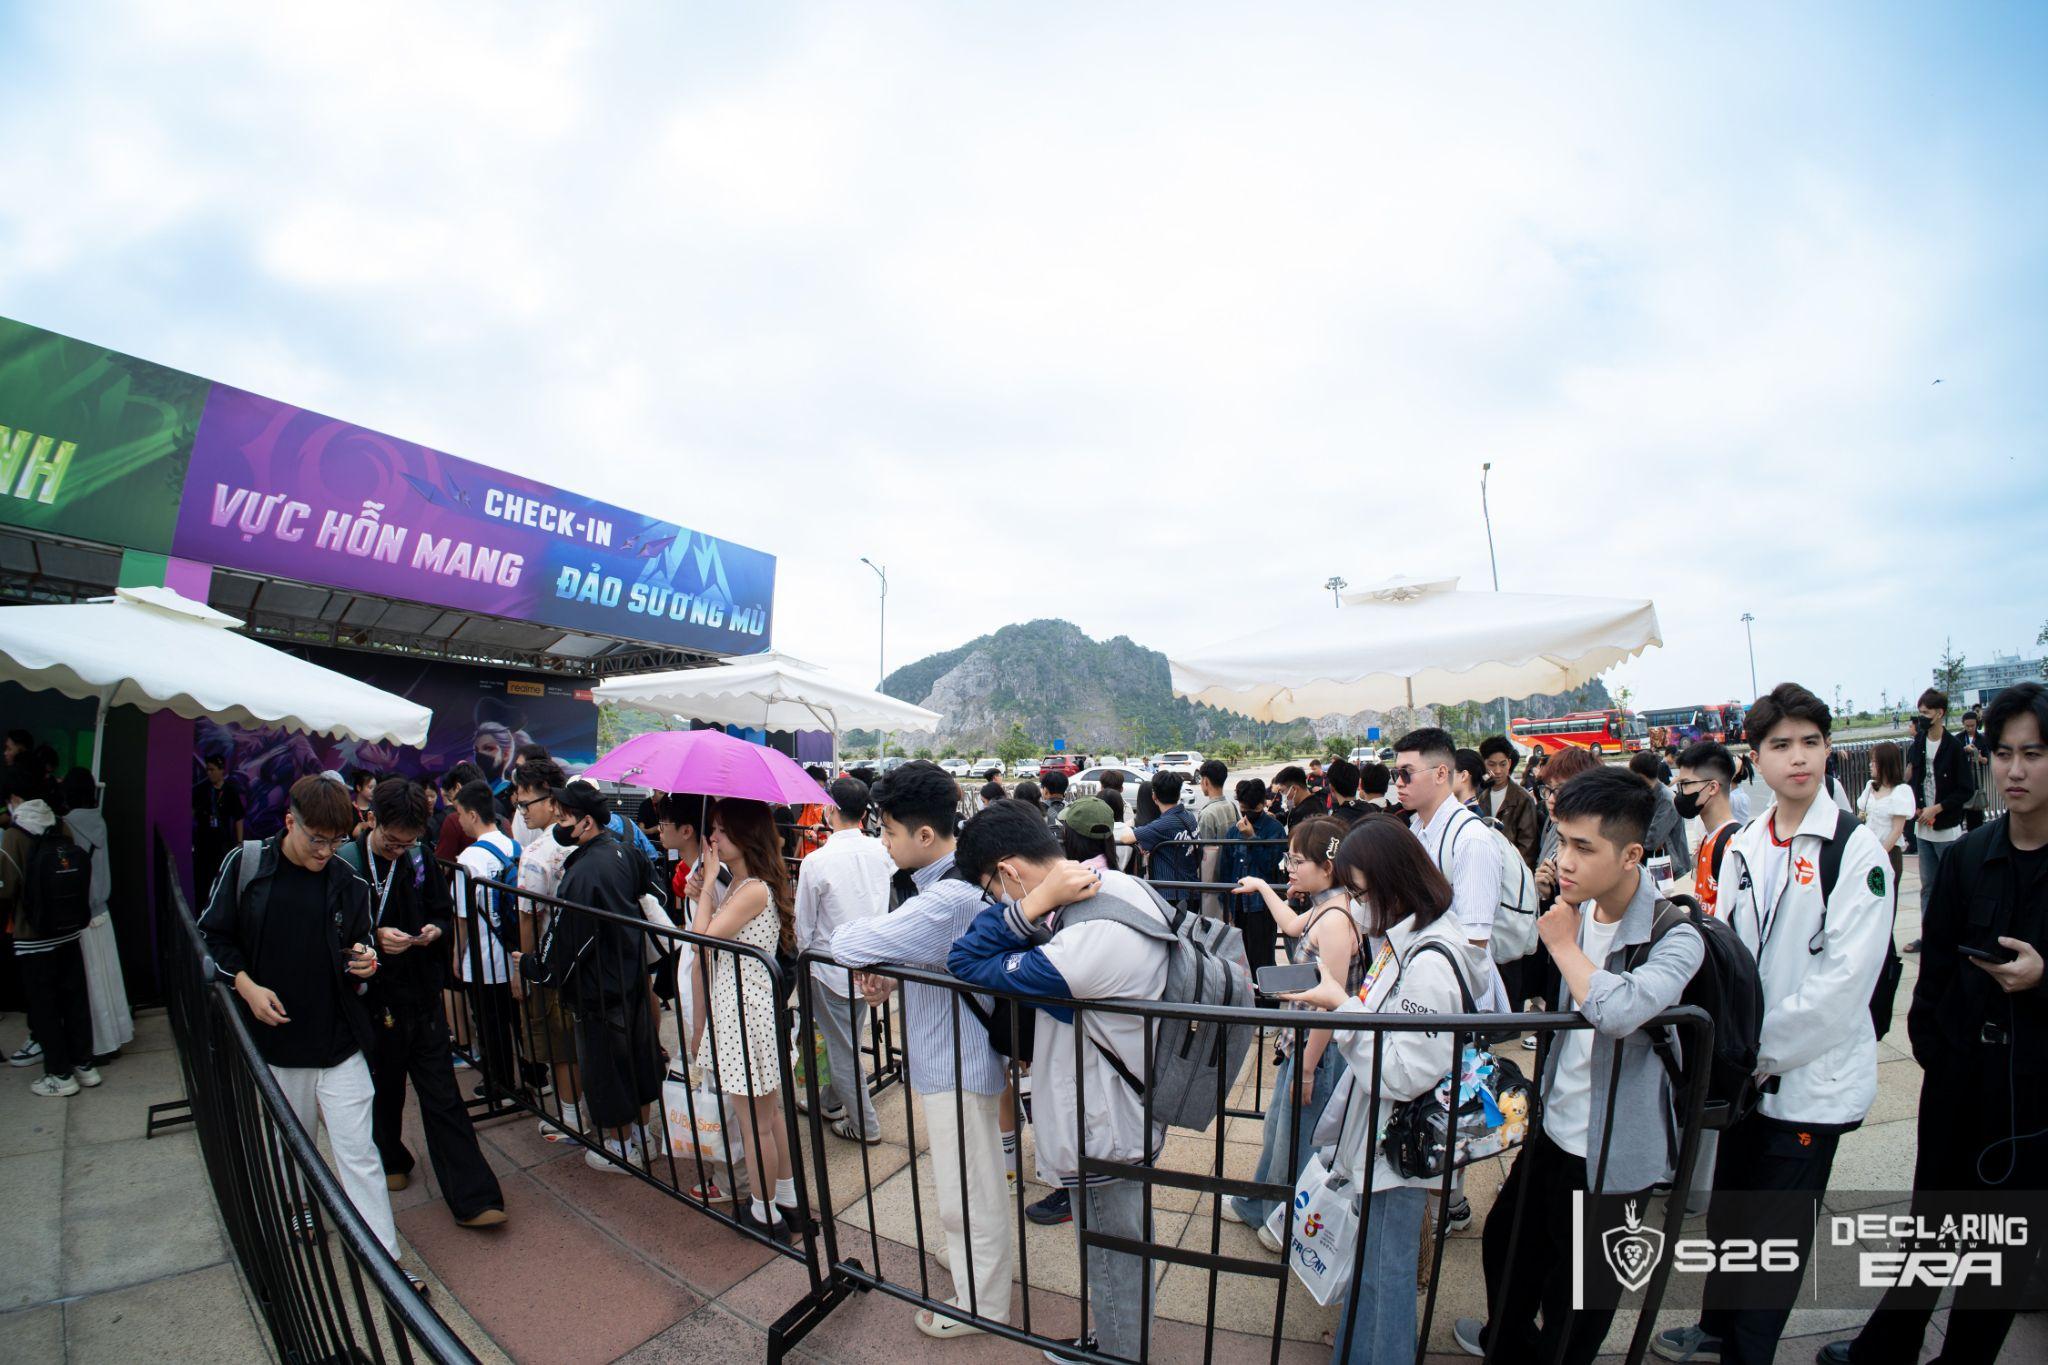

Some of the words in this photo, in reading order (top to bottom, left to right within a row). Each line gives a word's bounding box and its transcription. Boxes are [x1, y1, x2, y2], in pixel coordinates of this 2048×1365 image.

[210, 483, 311, 543] VỰC
[315, 500, 408, 564] HỖN
[411, 532, 525, 589] MANG
[484, 488, 613, 547] CHECK-IN
[556, 562, 623, 608] ĐẢO
[627, 581, 725, 629] SƯƠNG
[728, 603, 766, 636] MÙ
